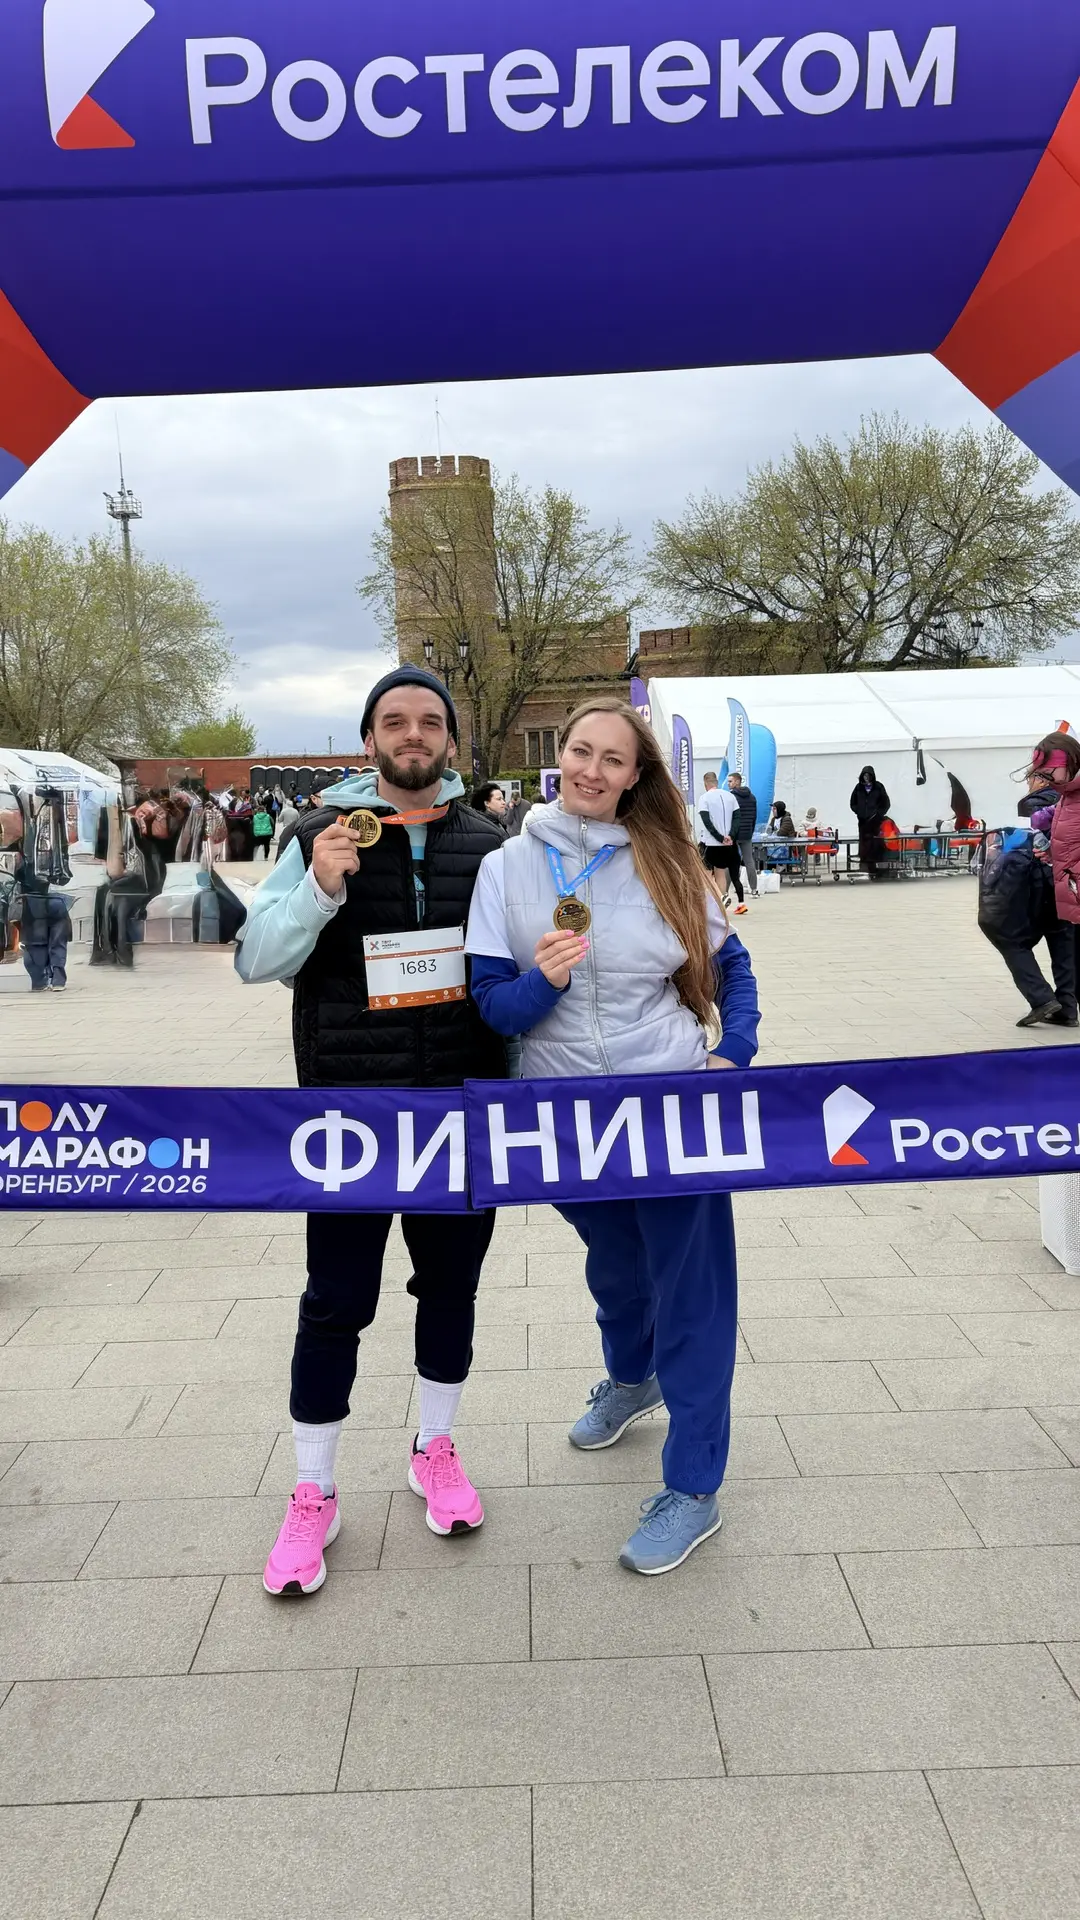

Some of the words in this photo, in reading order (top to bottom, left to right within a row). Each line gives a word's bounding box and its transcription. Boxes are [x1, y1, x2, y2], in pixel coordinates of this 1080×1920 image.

[184, 25, 959, 145] Ростелеком
[399, 958, 437, 975] 1683
[290, 1090, 766, 1192] ФИНИШ
[889, 1117, 1080, 1163] Росте
[0, 1173, 121, 1194] РЕНБУРГ
[140, 1174, 208, 1194] 2026
